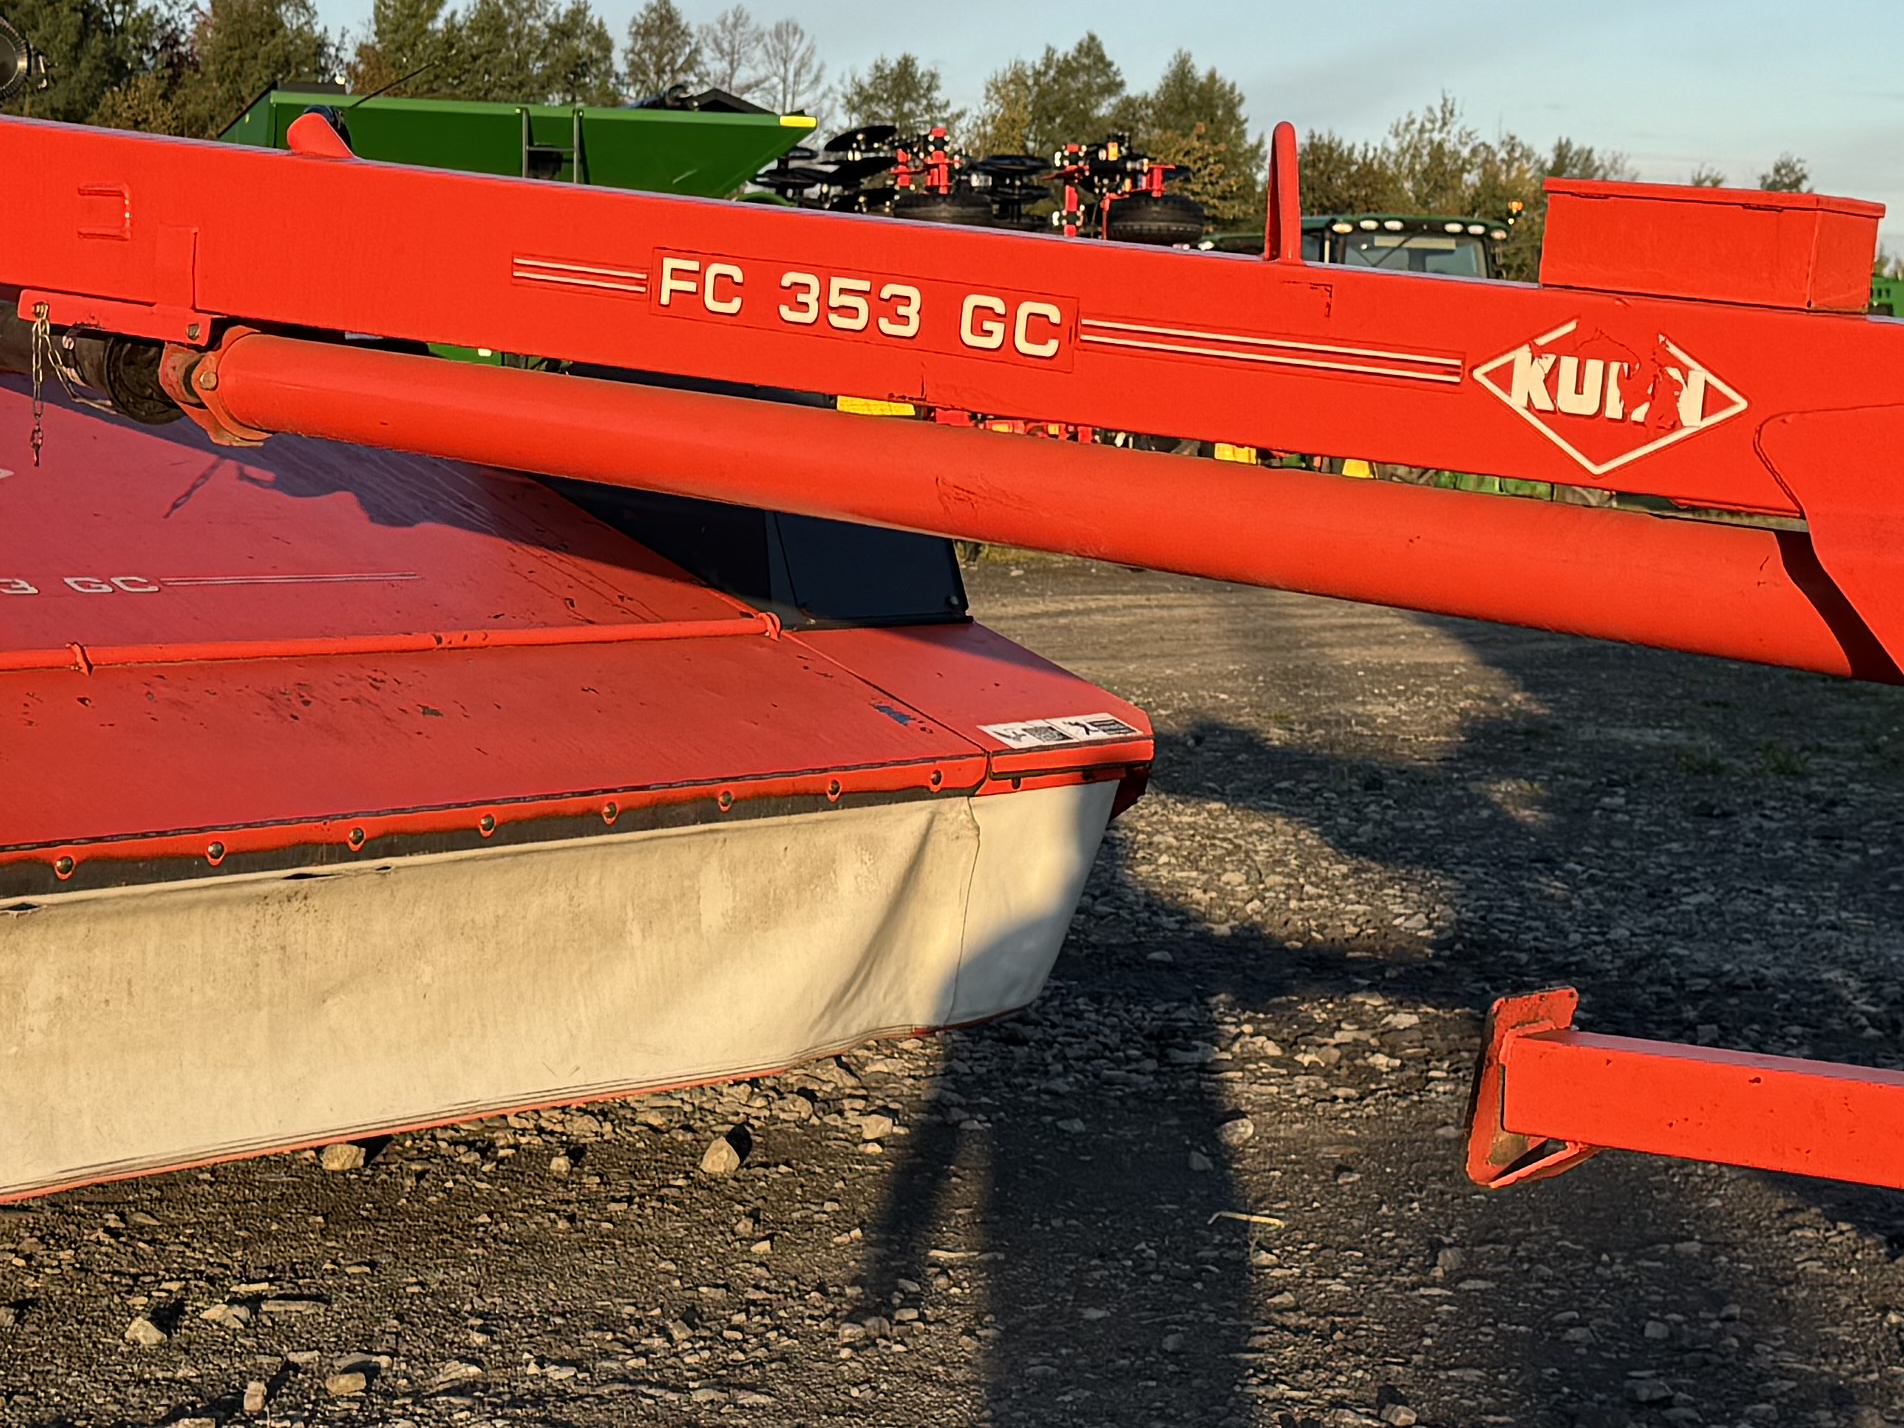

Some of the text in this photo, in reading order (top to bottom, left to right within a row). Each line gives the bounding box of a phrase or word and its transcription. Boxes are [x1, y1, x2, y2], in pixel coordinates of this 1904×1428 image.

[658, 256, 1062, 359] FC 353 GC
[62, 575, 161, 595] GC
